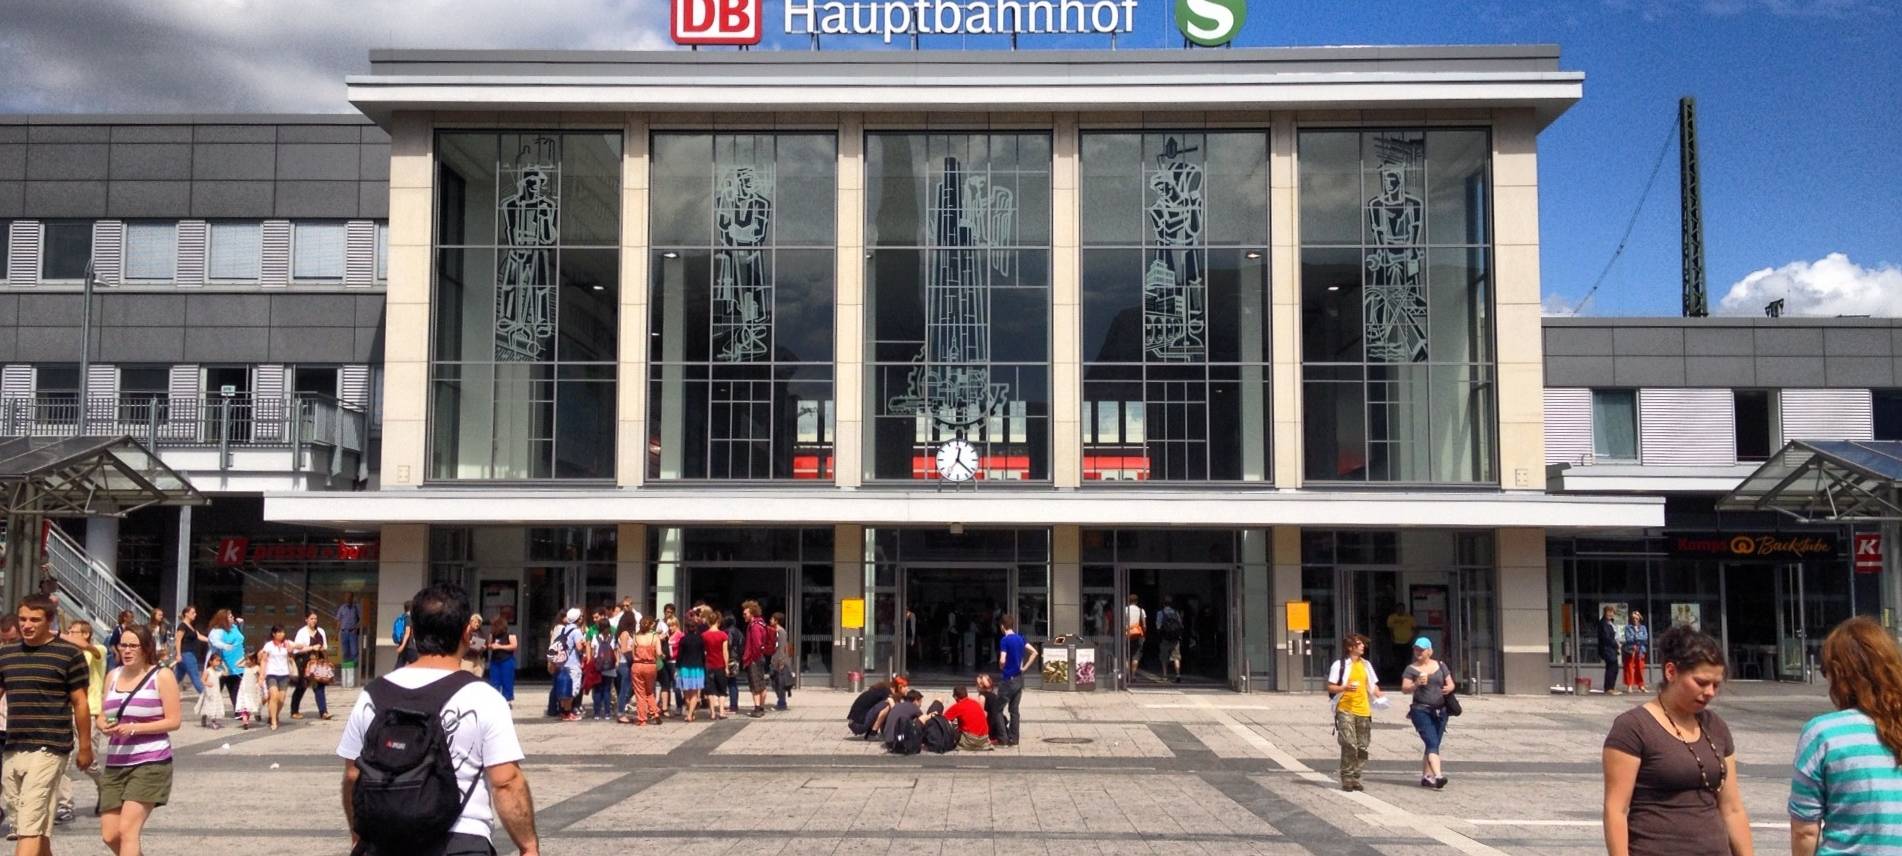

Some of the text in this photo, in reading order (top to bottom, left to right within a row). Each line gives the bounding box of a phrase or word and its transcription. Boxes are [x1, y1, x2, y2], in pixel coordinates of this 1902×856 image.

[683, 0, 750, 33] DB
[784, 0, 1137, 44] Hauptbahnhof
[1186, 0, 1234, 40] S
